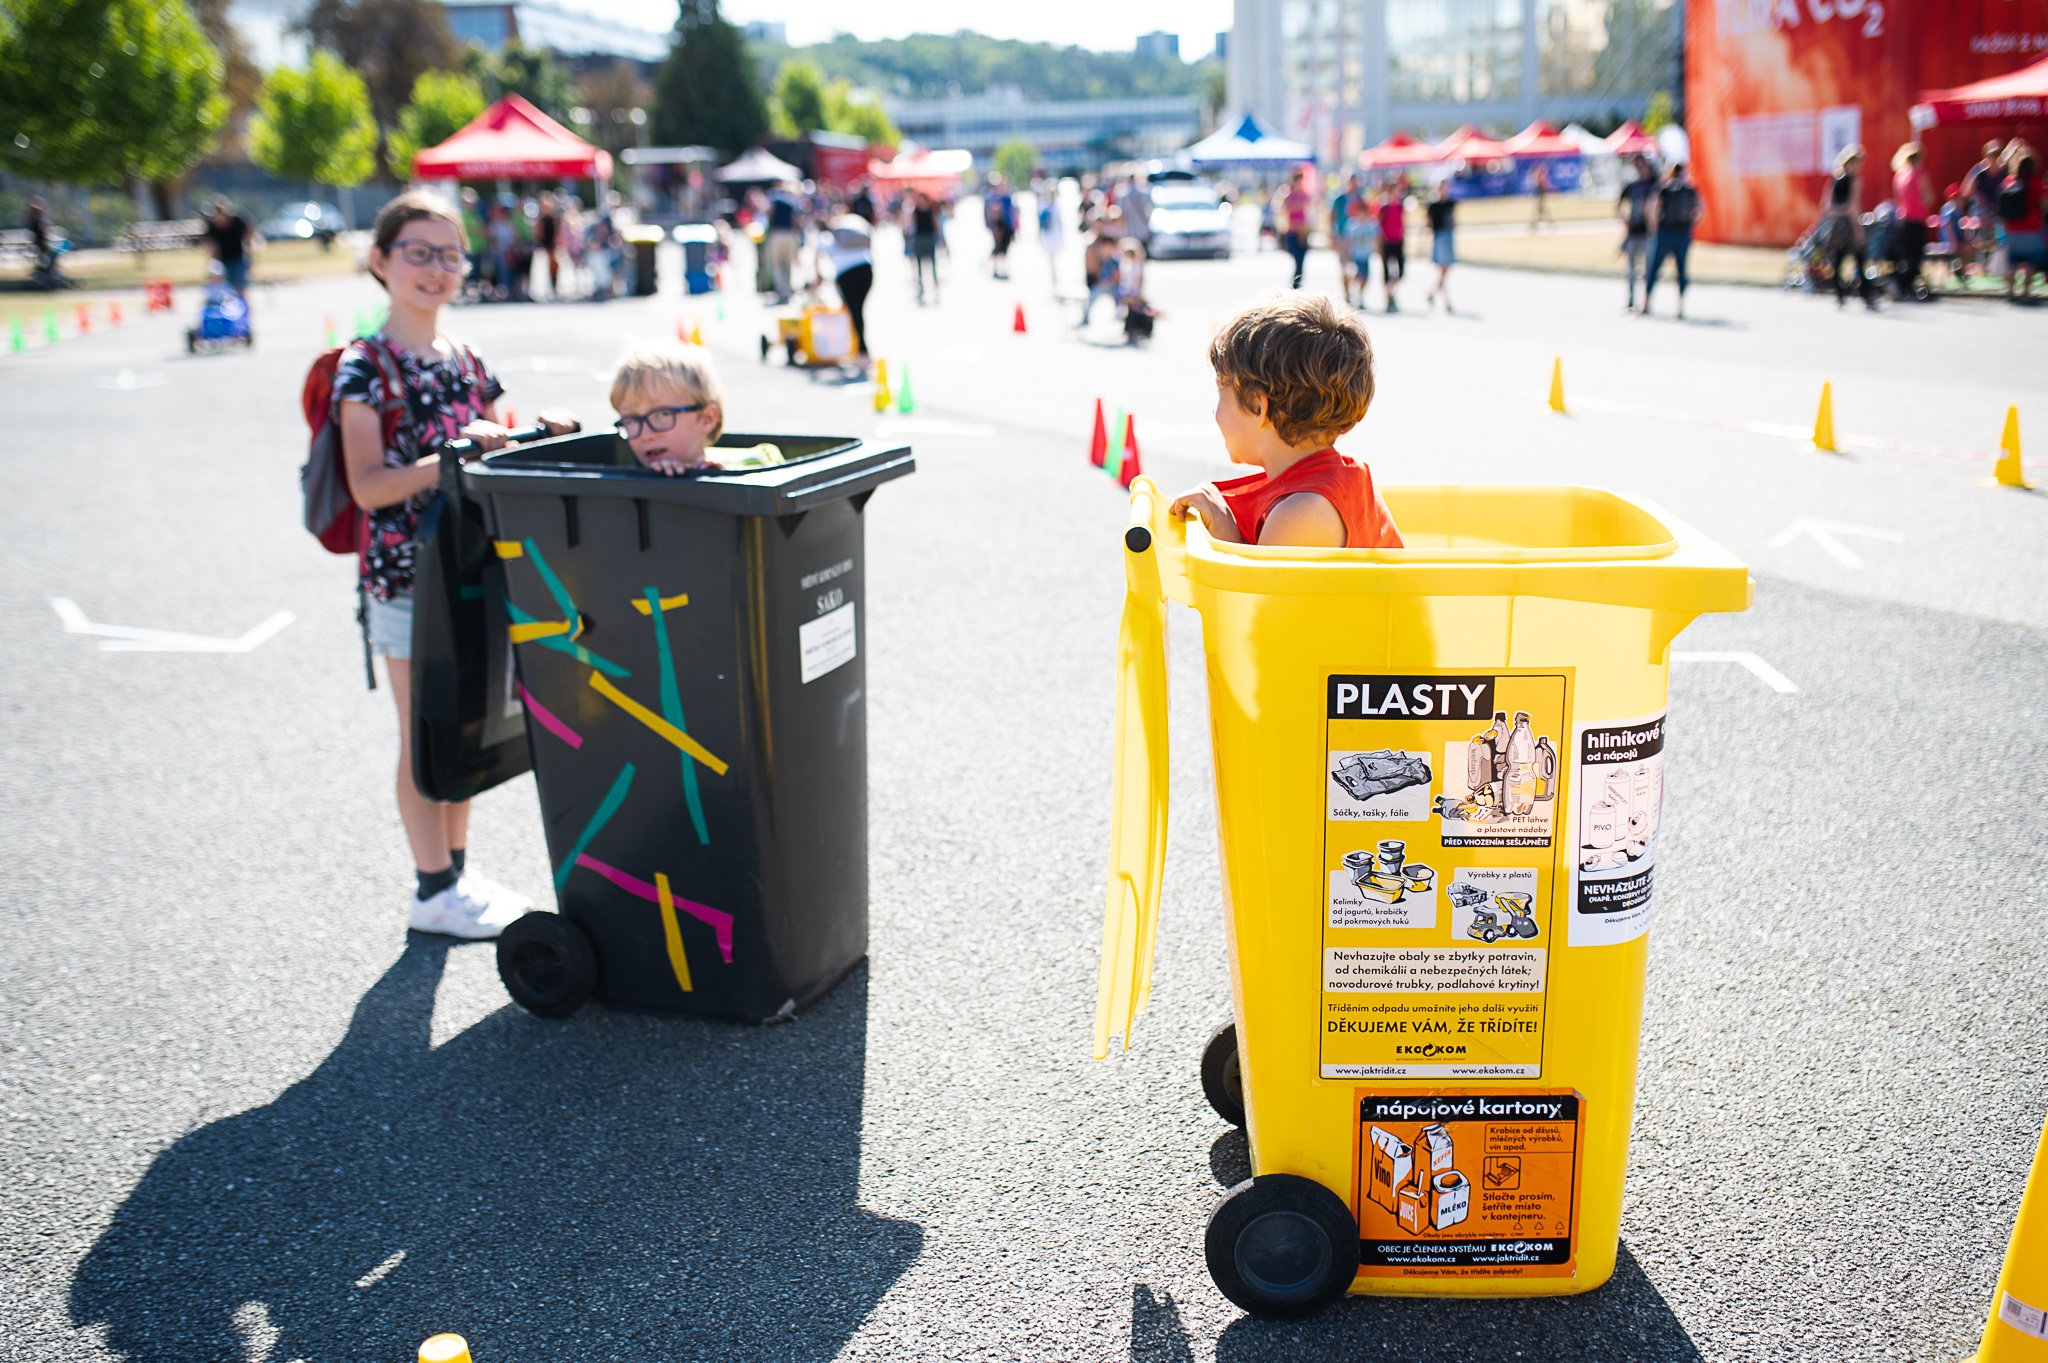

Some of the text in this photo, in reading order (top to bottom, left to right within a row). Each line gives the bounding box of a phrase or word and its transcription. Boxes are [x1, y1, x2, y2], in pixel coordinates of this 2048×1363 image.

[1336, 683, 1487, 715] PLASTY
[1587, 723, 1660, 749] hliníkové
[1586, 748, 1638, 761] od nápojů
[1333, 808, 1409, 818] Sáčky, tašky, fólie
[1484, 826, 1516, 834] plastové
[1519, 826, 1548, 834] nádoby
[1444, 837, 1549, 846] PŘED VHOZENÍM SEŠLÁPNĚTE
[1468, 871, 1501, 880] Výrobky
[1509, 871, 1532, 879] plastů
[1584, 876, 1647, 895] NEVHAZUJTE
[1333, 898, 1363, 906] Kelímky
[1588, 895, 1612, 904] (NAPŘ.
[1344, 908, 1374, 916] jogurtů,
[1375, 908, 1408, 916] krabičky
[1344, 918, 1391, 926] pokrmových
[1334, 951, 1396, 964] Nevhazujte
[1399, 951, 1430, 964] obaly
[1448, 951, 1485, 964] zbytky
[1488, 951, 1537, 964] potravin,
[1335, 965, 1349, 975] od
[1352, 965, 1407, 975] chemikálií
[1420, 965, 1498, 977] nebezpečných
[1501, 965, 1532, 976] látek;
[1329, 979, 1539, 991] novodurové trubky, podlahové krytiny!
[1328, 1003, 1539, 1015] Tříděním odpadu umožníte jeho další využití
[1328, 1018, 1537, 1035] DĚKUJEME VÁM, ŽE TŘÍDÍTE!
[1335, 1066, 1525, 1076] www.jaktridit.cz www.ekokom.cz
[1376, 1098, 1562, 1120] nápojové kartony
[1522, 1126, 1533, 1134] od
[1535, 1126, 1561, 1135] džusů,
[1489, 1135, 1564, 1144] mléčných výrobků,
[1503, 1143, 1527, 1152] apod.
[1433, 1149, 1452, 1167] KEFÍR
[1374, 1157, 1391, 1188] Víno
[1483, 1192, 1556, 1203] Stlačte prosím,
[1400, 1200, 1414, 1222] JUICE
[1440, 1200, 1467, 1216] MLÉKO
[1482, 1203, 1512, 1211] šetříte
[1490, 1212, 1546, 1222] kontejneru.
[1377, 1245, 1401, 1253] OBEC
[1412, 1244, 1448, 1253] ČLENEM
[1449, 1243, 1486, 1253] SYSTÉMU
[1387, 1254, 1540, 1263] www.ekokom.cz www.jaktridit.cz
[1403, 1268, 1523, 1277] Děkujeme Vám, že třídíte odpady!
